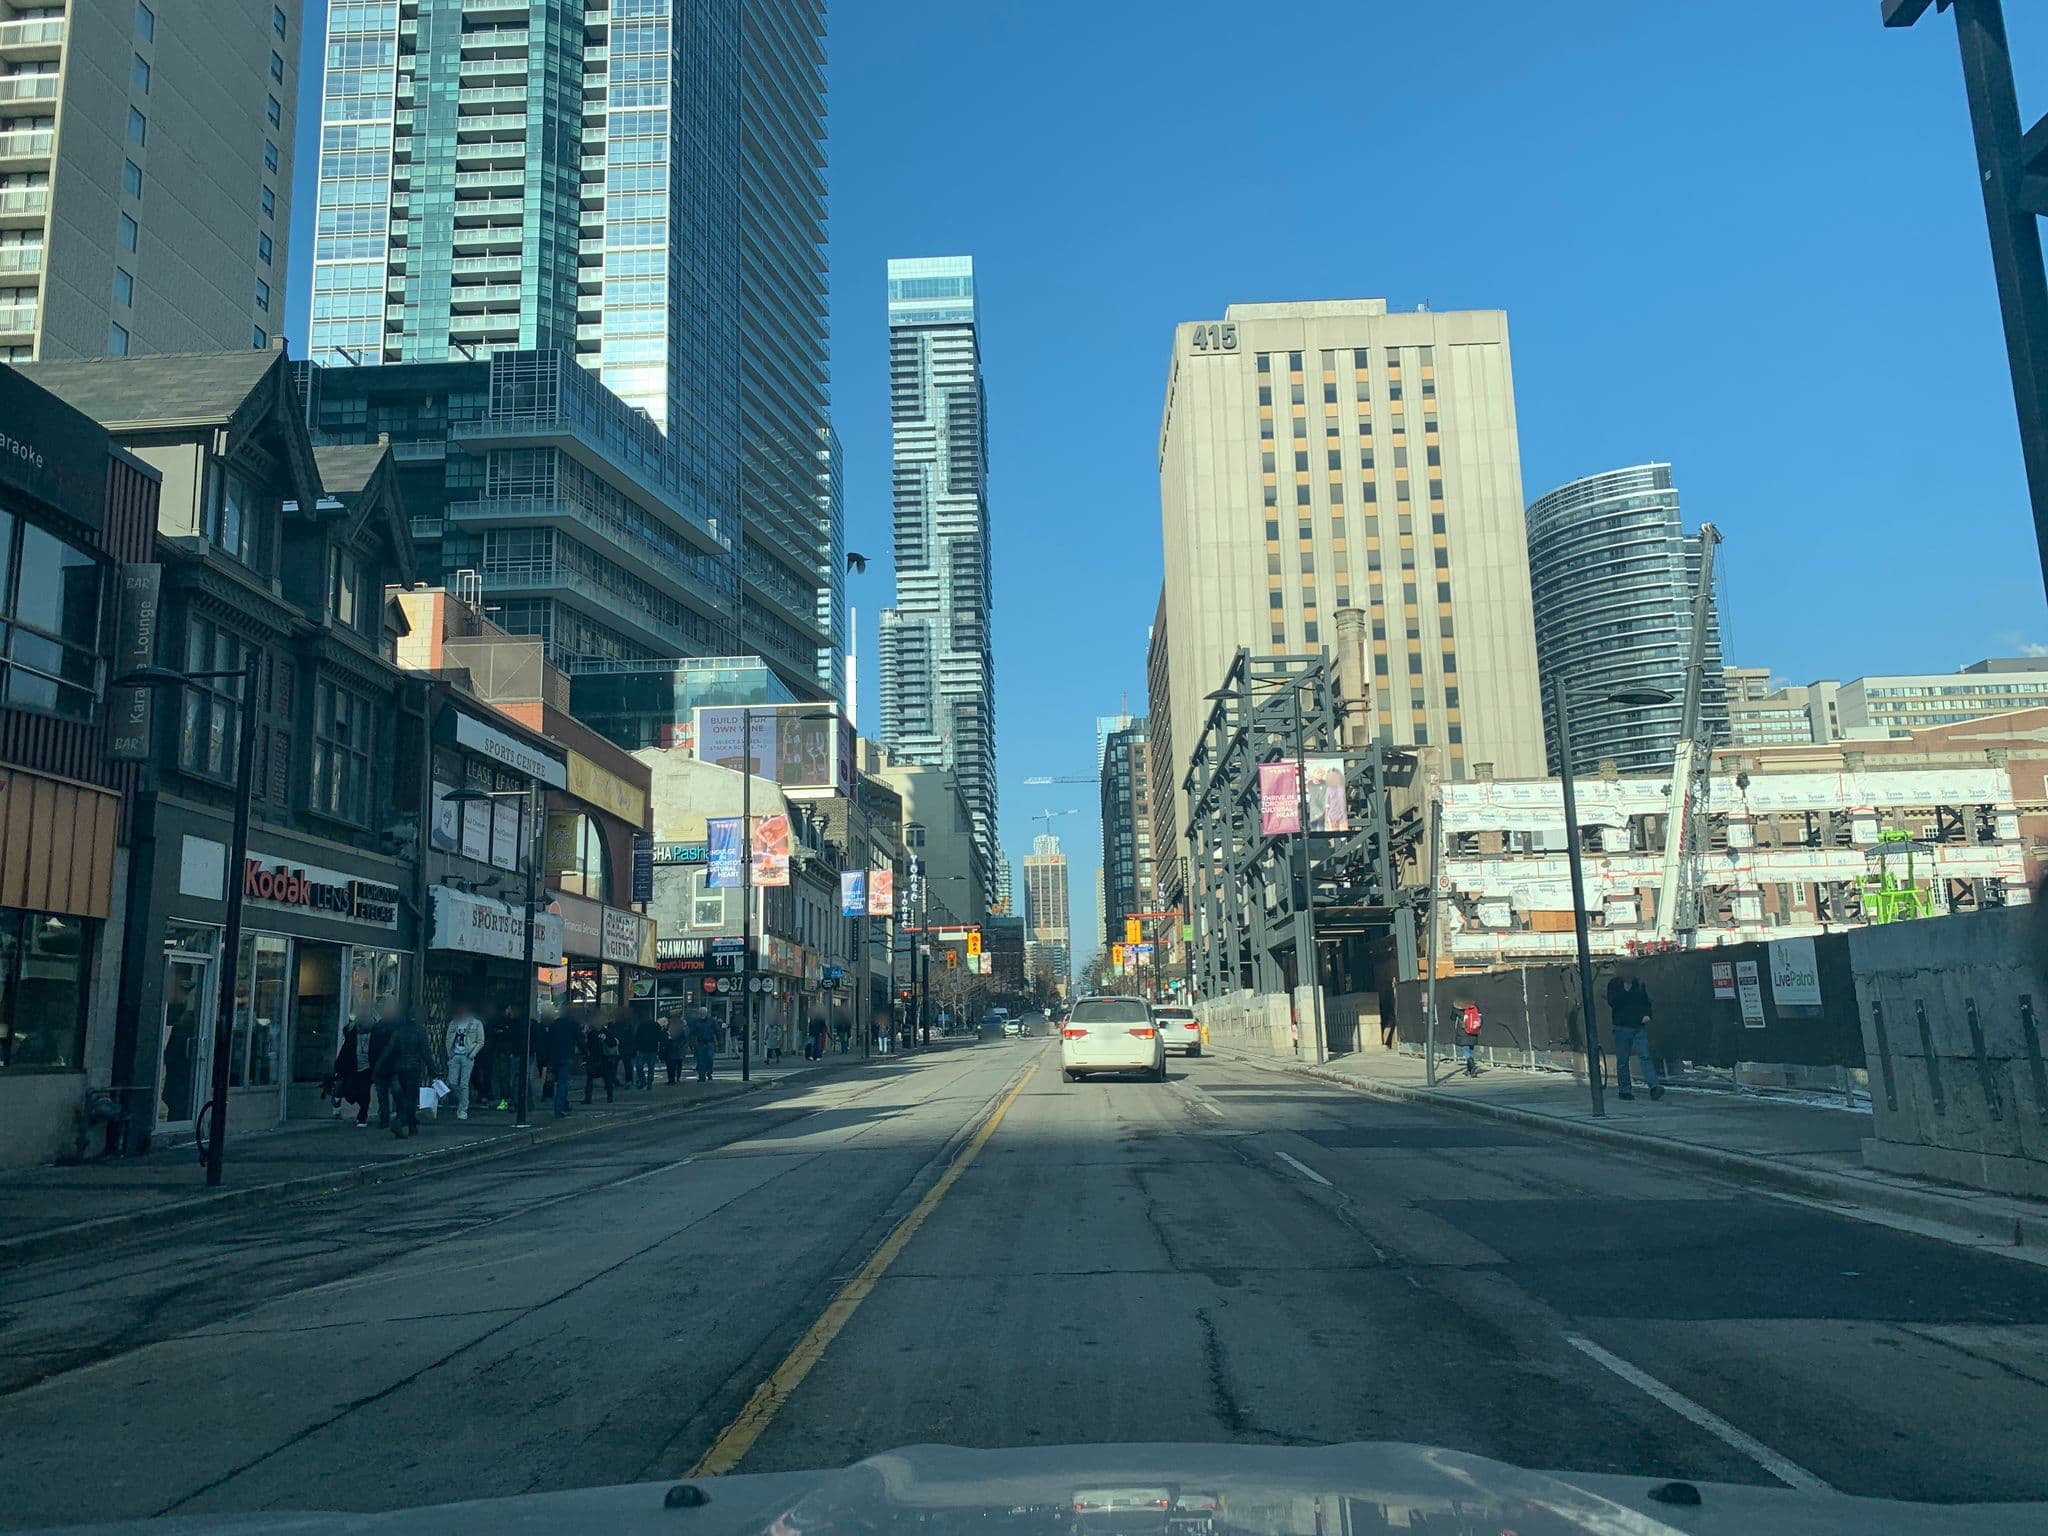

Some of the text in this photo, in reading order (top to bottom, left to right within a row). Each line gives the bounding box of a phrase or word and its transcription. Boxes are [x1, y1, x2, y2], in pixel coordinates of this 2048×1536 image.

[1193, 324, 1237, 350] 415
[134, 601, 155, 655] Lounge
[129, 663, 147, 724] Karae
[711, 716, 738, 725] BUILD
[713, 726, 736, 734] OWN
[485, 738, 546, 777] SPORTS CENTRE
[466, 759, 492, 786] LEASE
[245, 858, 350, 912] Kodak LENS
[910, 854, 918, 902] Yonge
[1158, 883, 1166, 920] Yone
[472, 910, 546, 941] SPORTS CERE
[610, 941, 630, 958] GIFTS
[656, 940, 704, 959] SHAWARMA
[656, 961, 704, 970] REVOLUTION
[1774, 970, 1816, 988] LivePatrol
